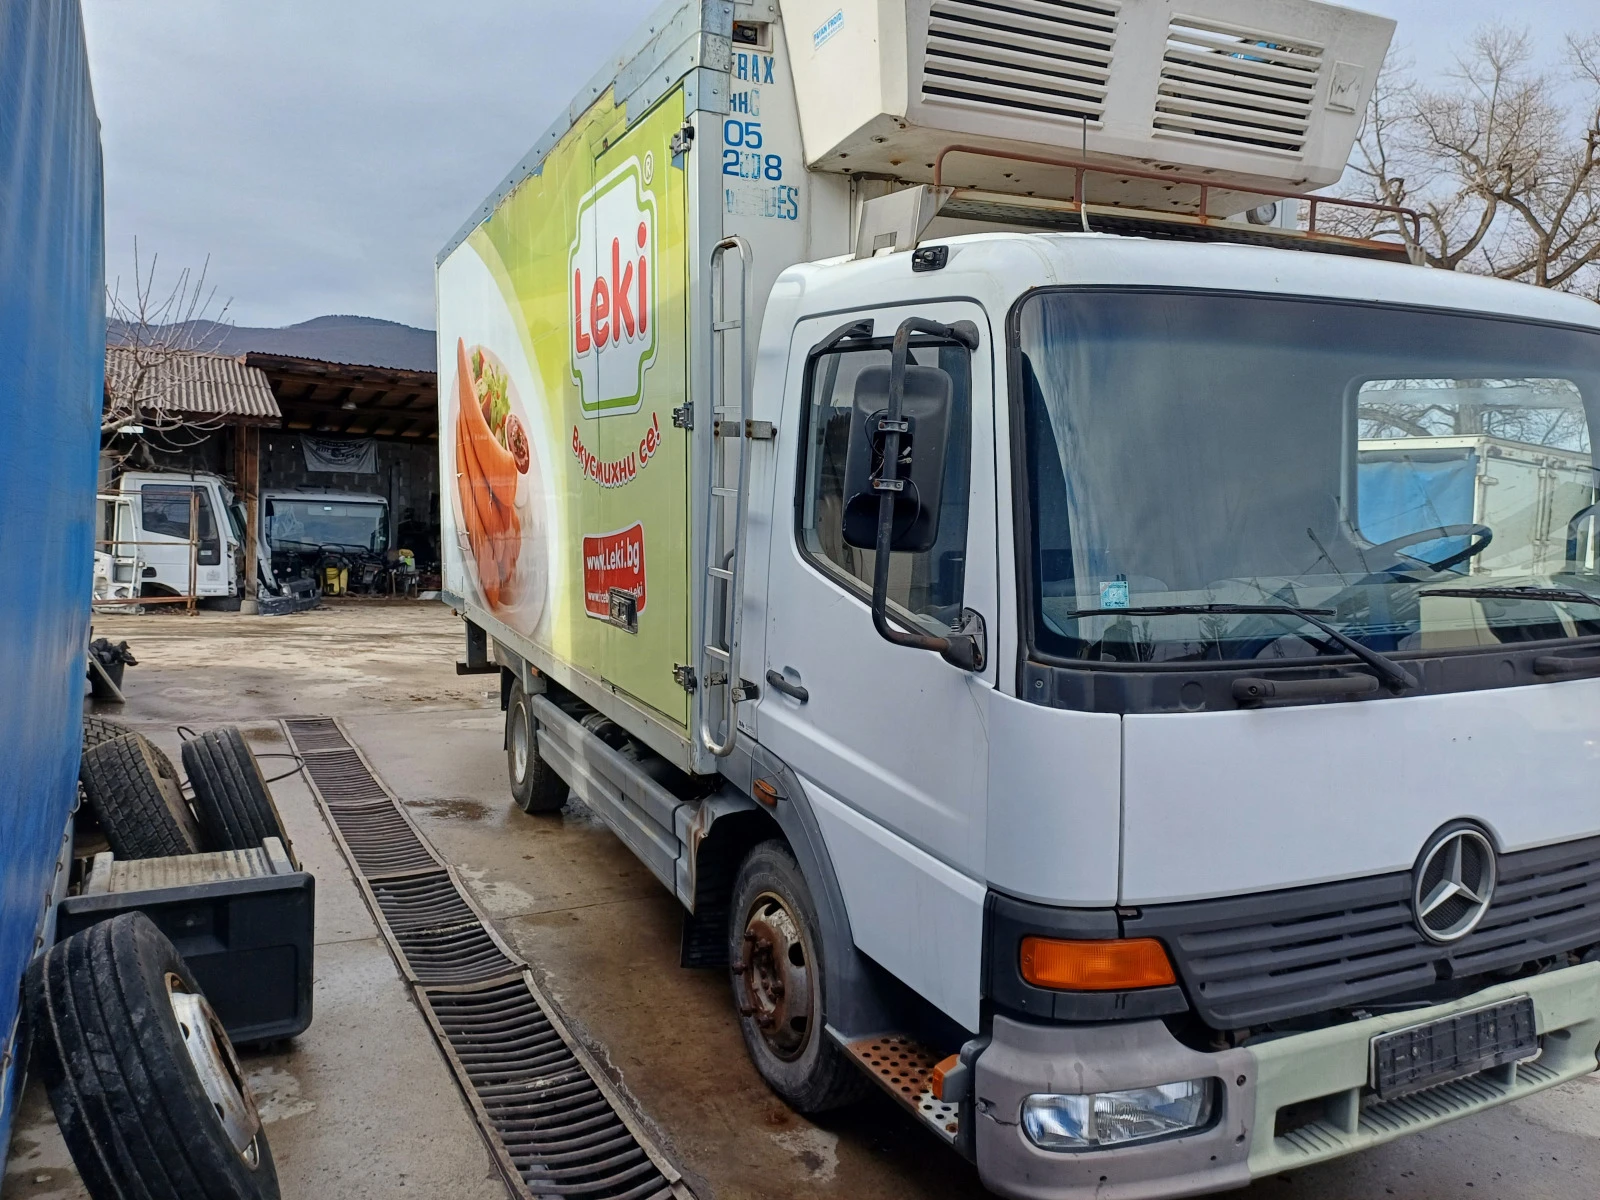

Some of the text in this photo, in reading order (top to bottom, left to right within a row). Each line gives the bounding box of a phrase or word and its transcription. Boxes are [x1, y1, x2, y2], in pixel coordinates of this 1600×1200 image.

[724, 120, 763, 149] 05
[574, 221, 647, 354] Leki
[572, 412, 661, 485] Вкусмихни се!
[586, 537, 640, 575] www.Leki.bg
